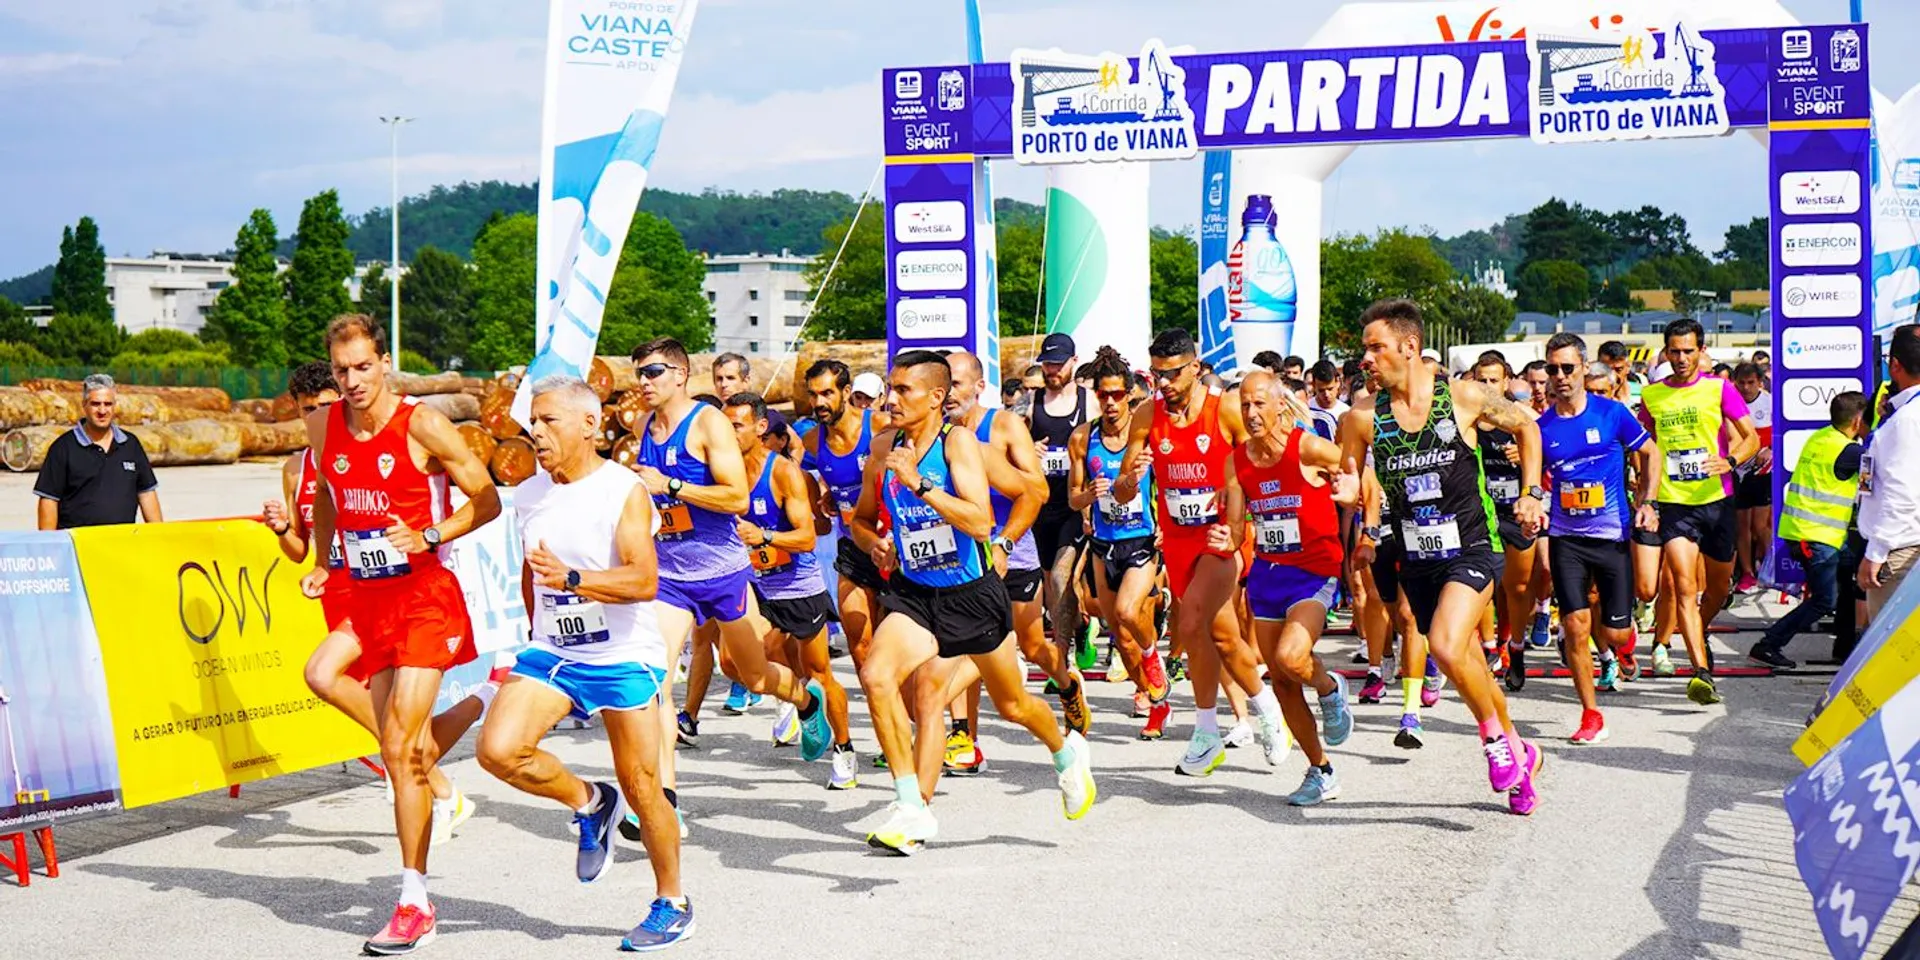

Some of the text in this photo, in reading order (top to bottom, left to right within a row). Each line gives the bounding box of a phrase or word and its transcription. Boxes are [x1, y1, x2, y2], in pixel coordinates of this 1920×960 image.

[580, 13, 673, 36] VIANA
[1612, 68, 1674, 91] Corrida
[1777, 67, 1819, 77] VIANA
[1203, 51, 1510, 136] PARTIDA
[1793, 85, 1845, 101] EVENT
[891, 106, 928, 115] VIANA
[1090, 94, 1147, 112] Corrida
[1794, 101, 1845, 116] SPORT
[1539, 103, 1719, 134] PORTO de VIANA
[905, 122, 951, 138] EVENT
[906, 137, 951, 150] SPORT
[1022, 127, 1188, 154] PORTO de VIANA
[1796, 195, 1845, 205] WestSEA
[908, 225, 952, 234] WestSEA
[1798, 237, 1857, 248] ENERCON
[911, 263, 963, 274] ENERCON
[1803, 343, 1857, 352] LANKHORST
[1046, 459, 1063, 469] 181
[1386, 448, 1457, 471] Gislotica
[1679, 462, 1699, 475] 626
[1578, 490, 1590, 503] 17
[1180, 503, 1201, 518] 612
[910, 539, 937, 559] 621
[1417, 536, 1443, 550] 306
[37, 556, 57, 571] DA
[360, 549, 388, 568] 610
[13, 578, 71, 595] OFFSHORE
[556, 616, 585, 635] 100
[192, 649, 283, 680] OCEAN WINDS
[133, 729, 141, 741] A
[143, 722, 174, 739] GERAR
[176, 721, 183, 733] O
[185, 714, 223, 732] FUTURO
[223, 712, 237, 725] DA
[238, 706, 276, 723] ENERGIA
